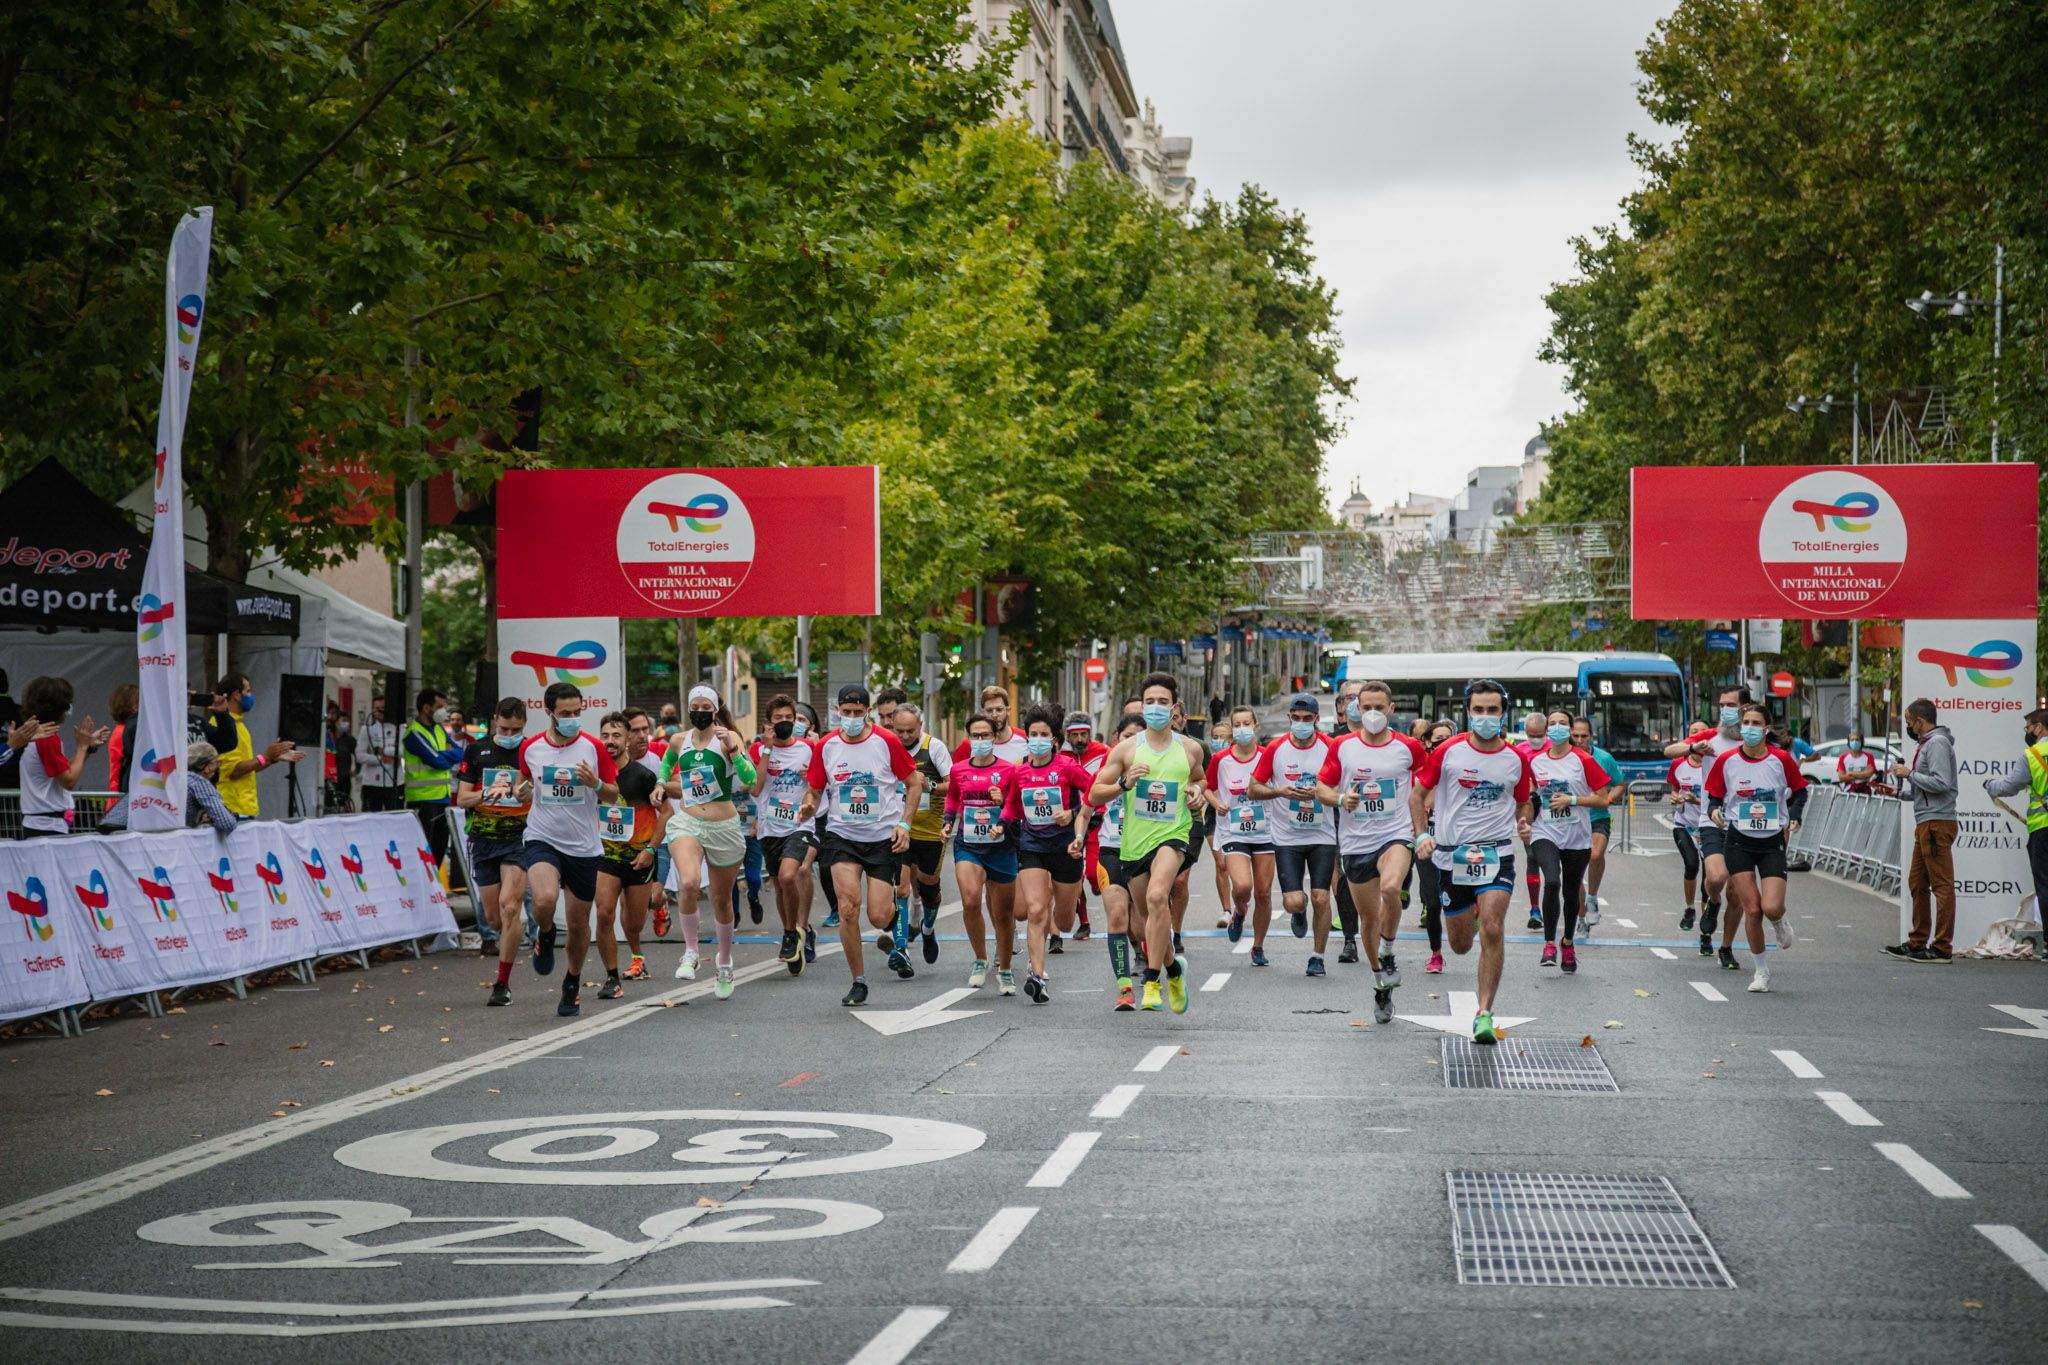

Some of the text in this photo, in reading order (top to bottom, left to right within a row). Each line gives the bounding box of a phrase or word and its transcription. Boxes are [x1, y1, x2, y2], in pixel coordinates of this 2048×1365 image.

[648, 541, 729, 553] TotalEnergies
[1792, 541, 1879, 553] TotalEnergies
[668, 566, 706, 575] MILLA
[1813, 566, 1854, 576] MILLA
[654, 590, 721, 600] DE MADRID
[1798, 591, 1869, 601] DE MADRID
[1600, 680, 1613, 695] 51
[1935, 698, 2022, 713] talEnergies
[552, 785, 574, 797] 506
[692, 784, 710, 797] 483
[849, 803, 869, 814] 489
[1034, 806, 1053, 817] 493
[1146, 800, 1166, 813] 183
[1364, 800, 1384, 812] 109
[775, 808, 795, 820] 1133
[1296, 812, 1314, 822] 468
[1971, 810, 2001, 818] balance
[607, 824, 624, 834] 488
[1240, 821, 1257, 831] 492
[1750, 820, 1768, 829] 467
[1958, 821, 2012, 833] MILLA
[1957, 836, 2022, 849] URBANA
[1466, 864, 1486, 877] 491
